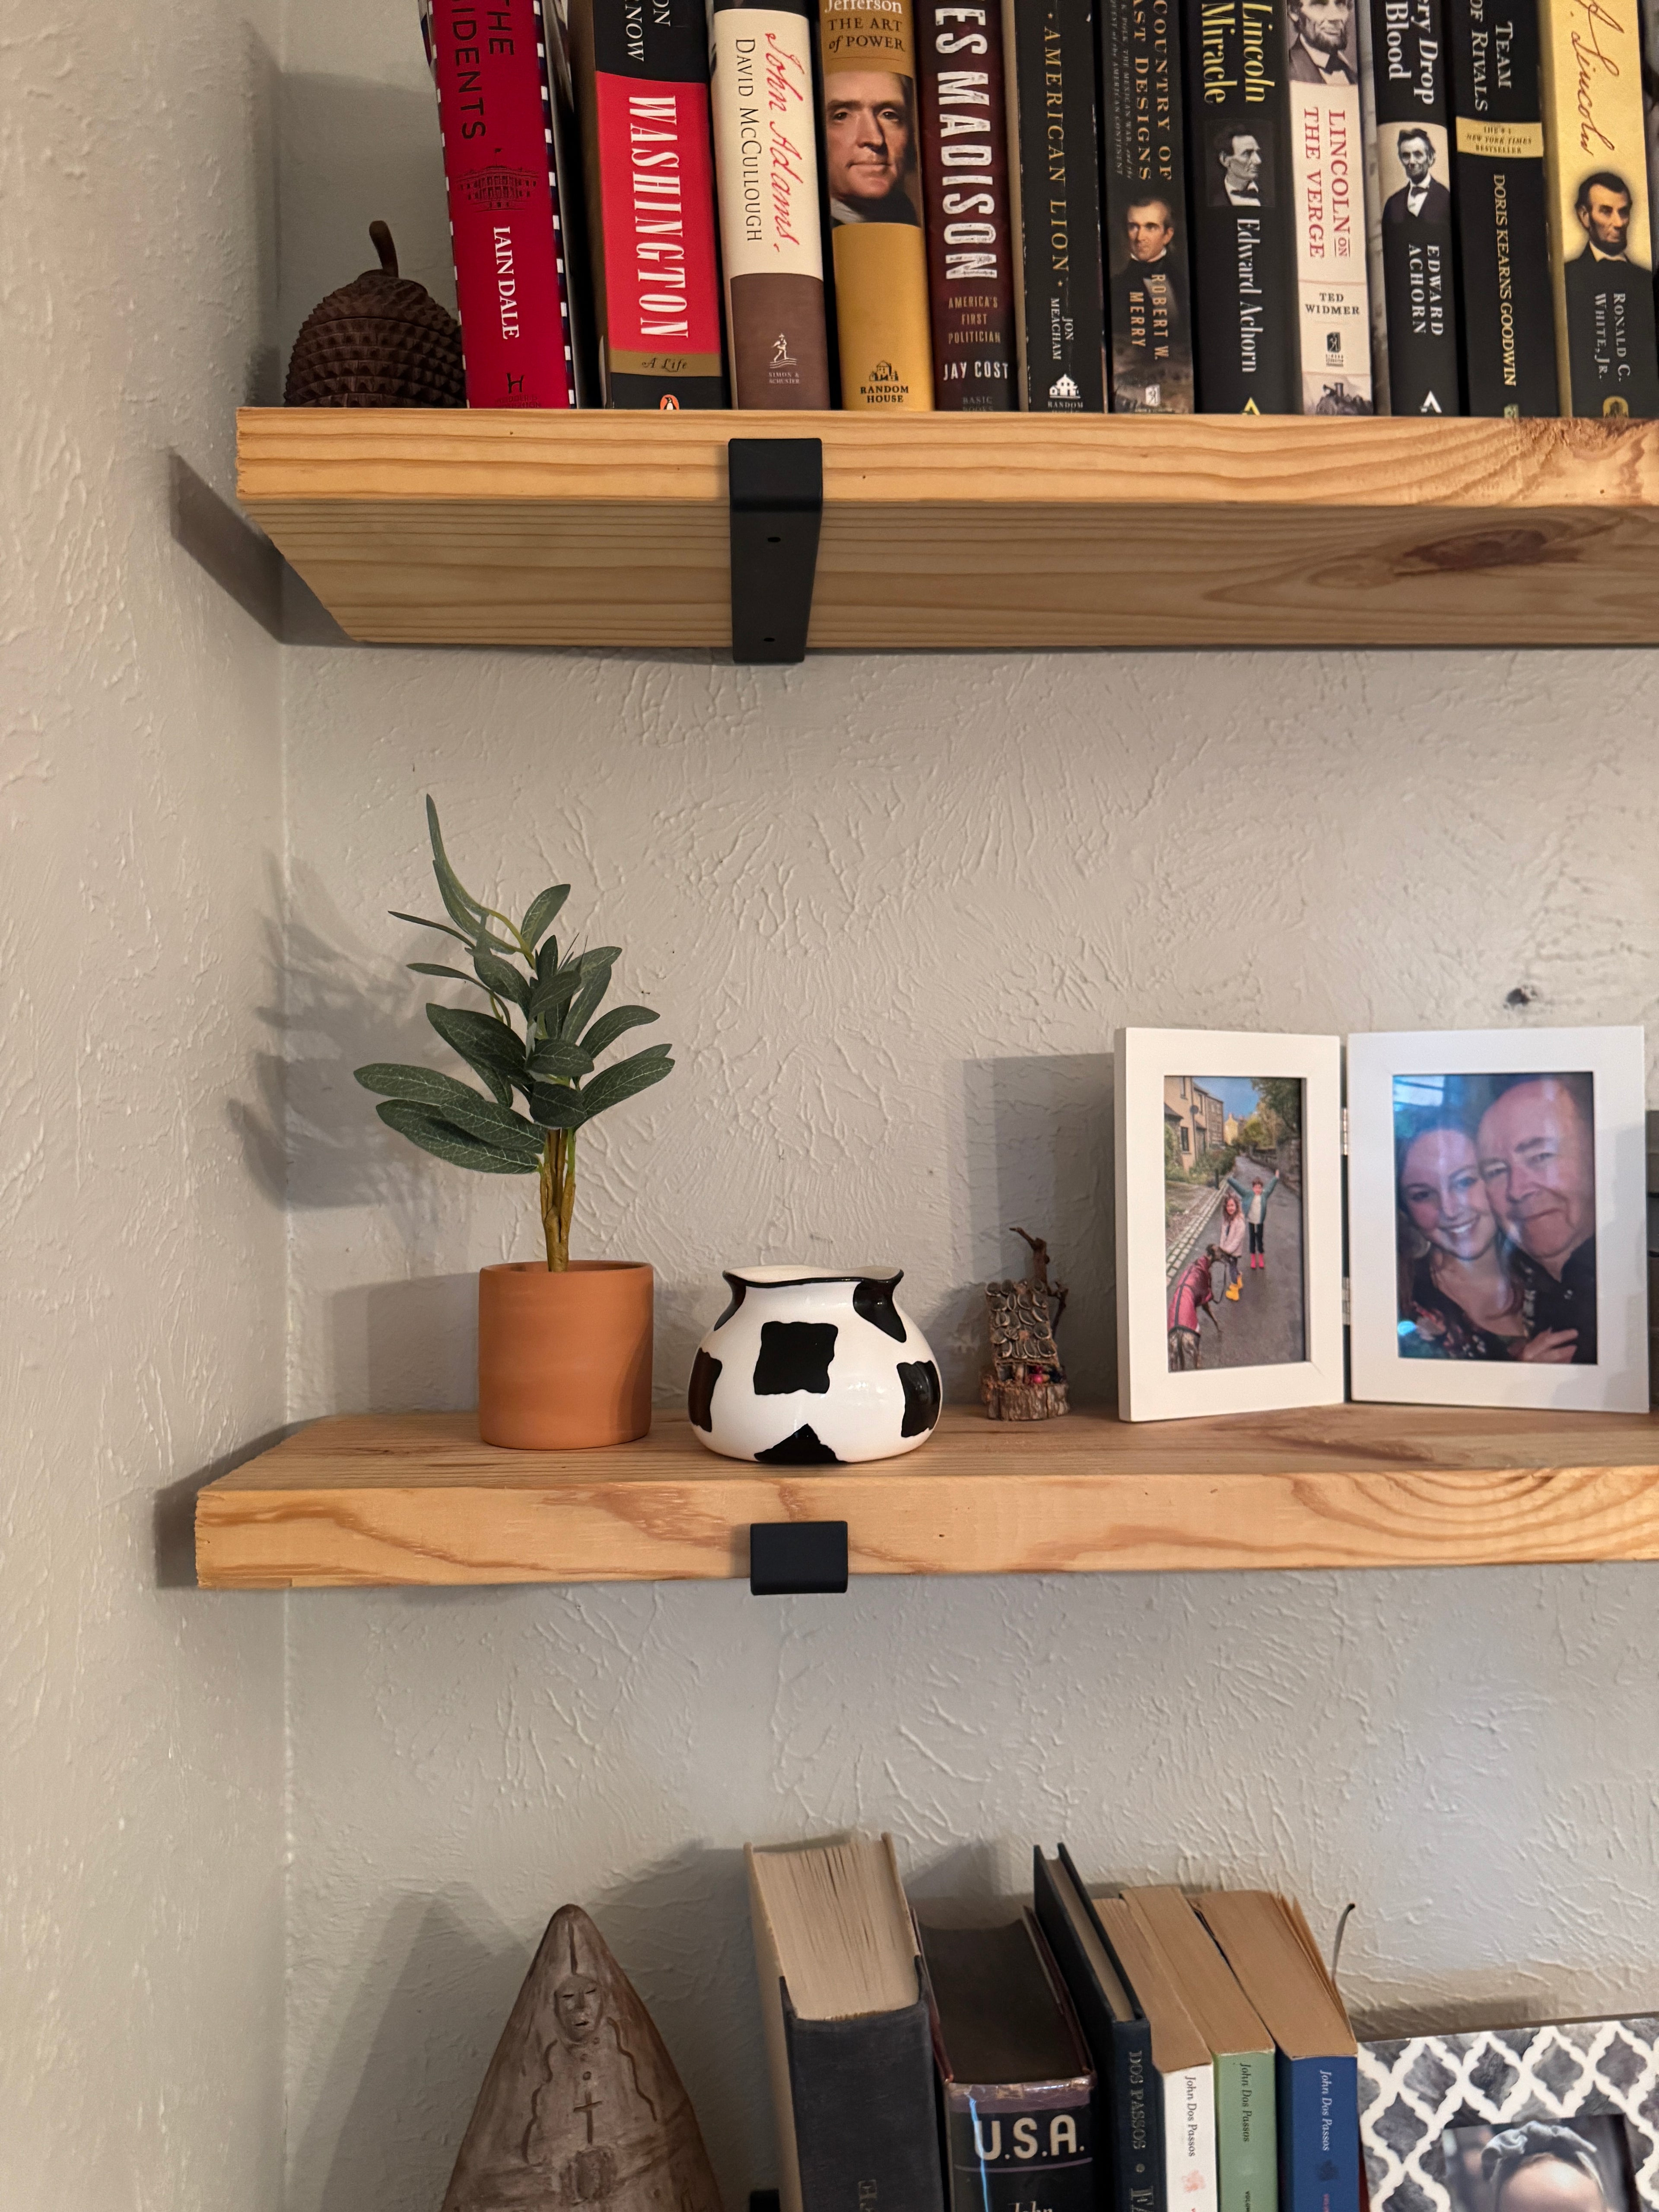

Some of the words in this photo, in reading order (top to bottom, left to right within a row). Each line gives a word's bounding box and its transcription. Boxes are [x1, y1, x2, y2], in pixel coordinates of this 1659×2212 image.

[625, 0, 645, 62] NOW
[824, 0, 903, 14] Jefferson
[828, 17, 864, 31] THE
[870, 17, 903, 32] ART
[1470, 0, 1484, 23] OF
[829, 35, 844, 53] of
[845, 35, 906, 52] POWER
[1154, 0, 1170, 130] COUNTRY
[1201, 2, 1238, 103] Miracle
[1242, 2, 1275, 102] Lincoln
[1386, 1, 1412, 81] Blood
[1495, 20, 1513, 89] TEAM
[735, 38, 755, 97] DAVID
[765, 33, 804, 112] John
[1413, 37, 1438, 105] Drop
[1471, 29, 1489, 112] RIVALS
[1044, 26, 1066, 187] AMERICAN
[1135, 57, 1151, 180] DESIGNS
[1304, 106, 1321, 159] THE
[1475, 145, 1522, 154] BESTSELLER
[937, 71, 998, 280] MADISON
[1159, 146, 1172, 180] OF
[1329, 109, 1350, 235] LINCOLN
[628, 95, 689, 339] WASHINGTON
[1306, 169, 1325, 258] VERGE
[1494, 174, 1508, 226] DORIS
[493, 226, 514, 275] IAIN
[1050, 200, 1069, 272] LION
[1237, 218, 1262, 294] Edward
[1338, 237, 1348, 257] ON
[1496, 228, 1512, 300] KEARNS
[498, 279, 520, 340] DALE
[948, 296, 998, 310] AMERICA'S
[1151, 274, 1168, 337] ROBERT
[1305, 304, 1360, 315] WIDMER
[1319, 292, 1344, 302] TED
[1408, 244, 1427, 334] ACHORN
[1427, 245, 1444, 336] EDWARD
[948, 331, 1001, 345] POLITICIAN
[961, 313, 988, 326] FIRST
[1051, 298, 1062, 360] MEACHAM
[1062, 316, 1074, 340] JON
[1129, 291, 1146, 347] MERRY
[1239, 301, 1264, 373] Achorn
[1595, 293, 1607, 353] WHITE,
[1613, 293, 1626, 358] RONALD
[642, 357, 658, 369] A
[662, 358, 688, 372] Life
[1154, 345, 1169, 360] W.
[1500, 302, 1516, 387] GOODWIN
[1594, 354, 1610, 380] JR.
[860, 385, 909, 394] RANDOM
[943, 362, 967, 381] JAY
[974, 360, 1009, 379] COST
[1618, 364, 1630, 382] C.
[867, 394, 904, 404] HOUSE
[963, 396, 993, 404] BASIC
[1128, 2050, 1144, 2085] DOS
[1185, 2075, 1196, 2101] John
[1240, 2063, 1252, 2087] John
[1320, 2070, 1332, 2095] John
[1130, 2088, 1146, 2150] PASSOS
[1186, 2103, 1196, 2122] Dos
[1241, 2088, 1252, 2108] Dos
[1322, 2098, 1332, 2116] Dos
[974, 2114, 1085, 2161] U.S.A.
[1187, 2124, 1198, 2157] Passos
[1242, 2110, 1252, 2143] Passos
[1322, 2118, 1333, 2152] Passos
